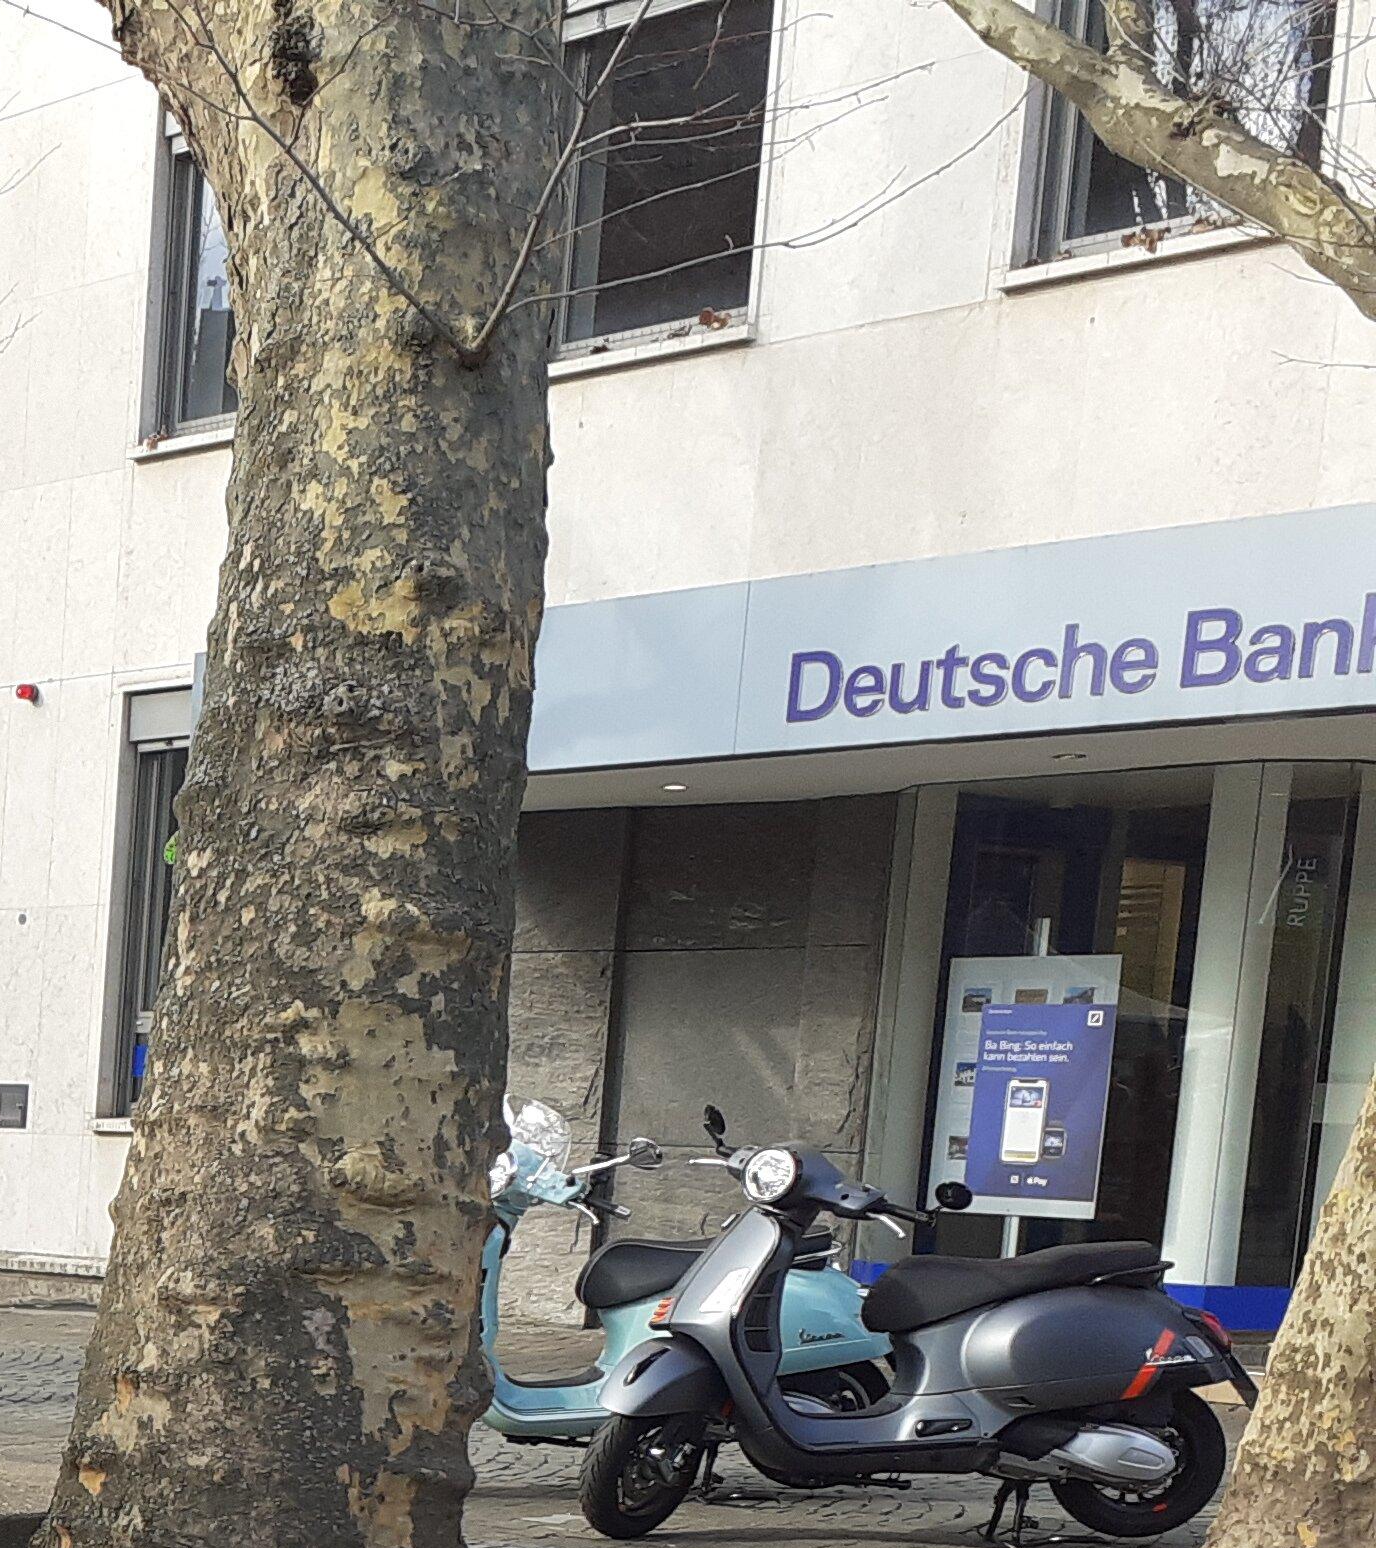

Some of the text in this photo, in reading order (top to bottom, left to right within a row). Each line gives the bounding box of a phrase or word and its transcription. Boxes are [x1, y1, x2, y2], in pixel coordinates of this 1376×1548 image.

[786, 623, 1159, 725] Deutsche
[1024, 1040, 1037, 1050] So
[1038, 1041, 1073, 1051] einfach
[983, 1051, 1006, 1061] kann
[1007, 1051, 1048, 1062] bezahlen
